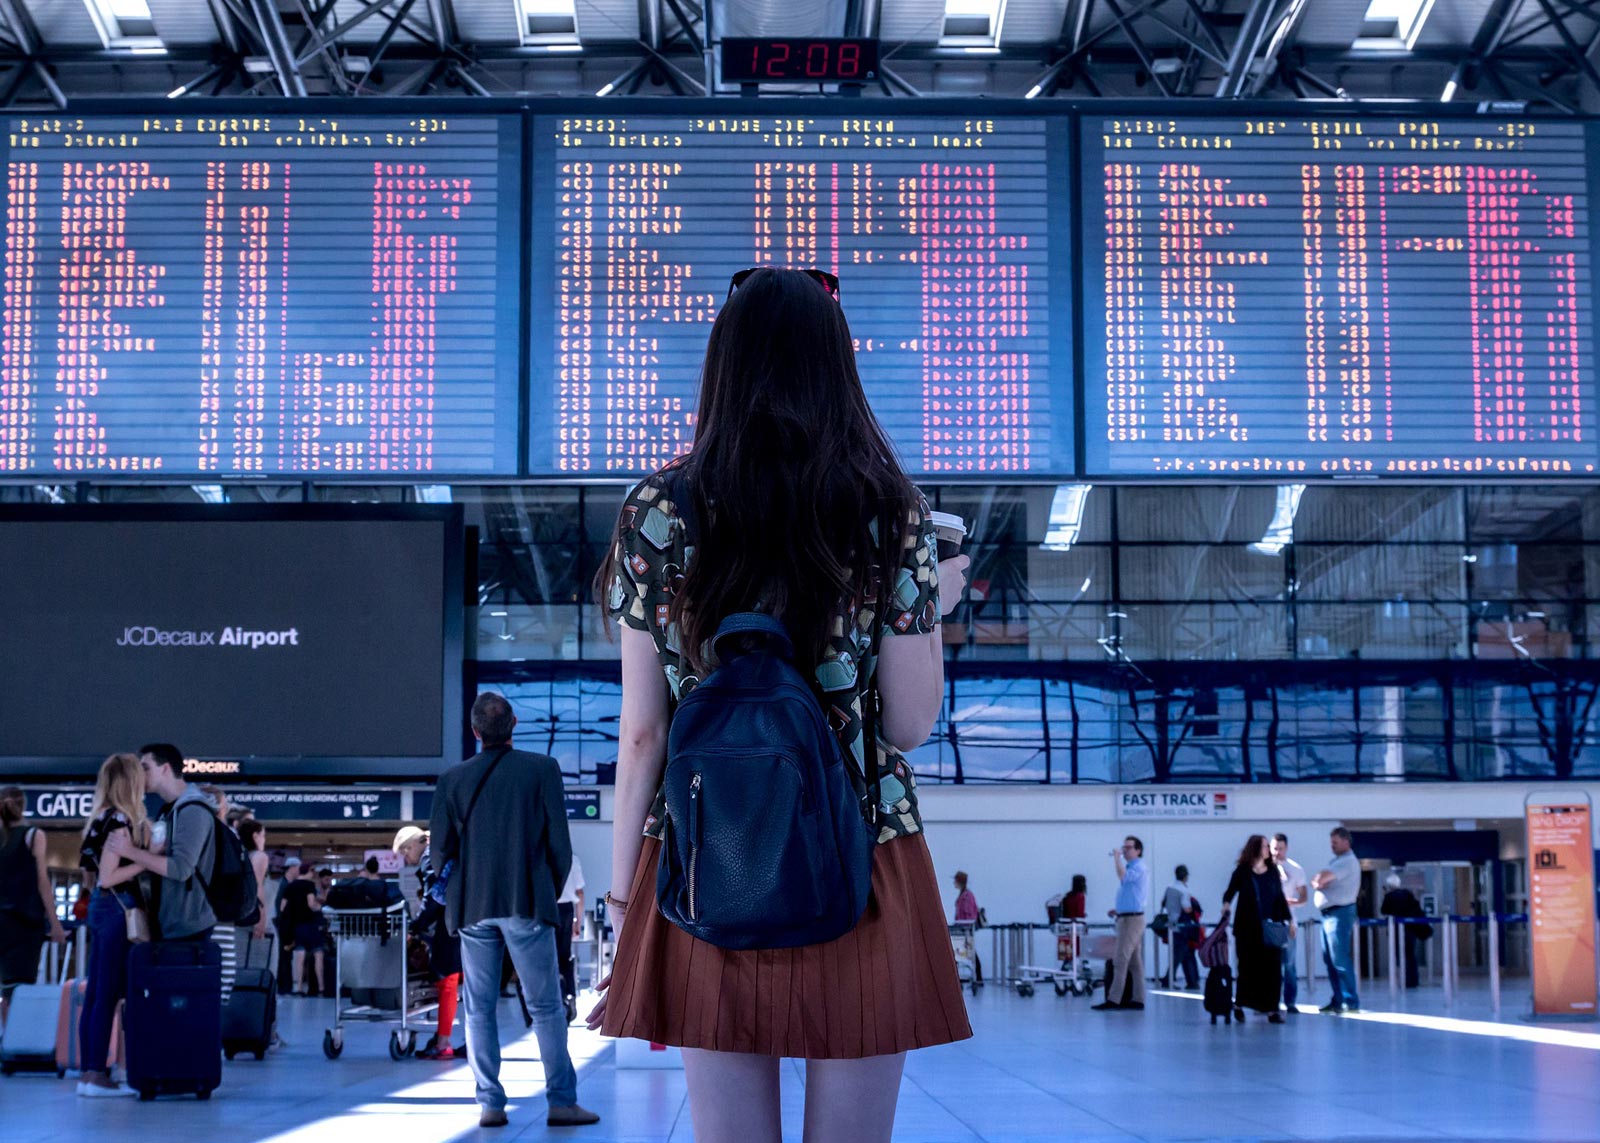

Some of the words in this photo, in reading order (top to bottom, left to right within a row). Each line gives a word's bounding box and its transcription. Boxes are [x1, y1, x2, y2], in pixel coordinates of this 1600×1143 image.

[751, 43, 861, 77] 12:08
[116, 626, 215, 646] JCDecaux
[219, 626, 299, 649] Airport
[253, 794, 287, 802] PASSPORT
[288, 794, 303, 802] AND
[304, 794, 338, 803] BOARDING
[339, 794, 356, 803] PASS
[356, 794, 379, 803] READY
[1123, 793, 1157, 806] FAST
[1161, 793, 1206, 806] TRACK
